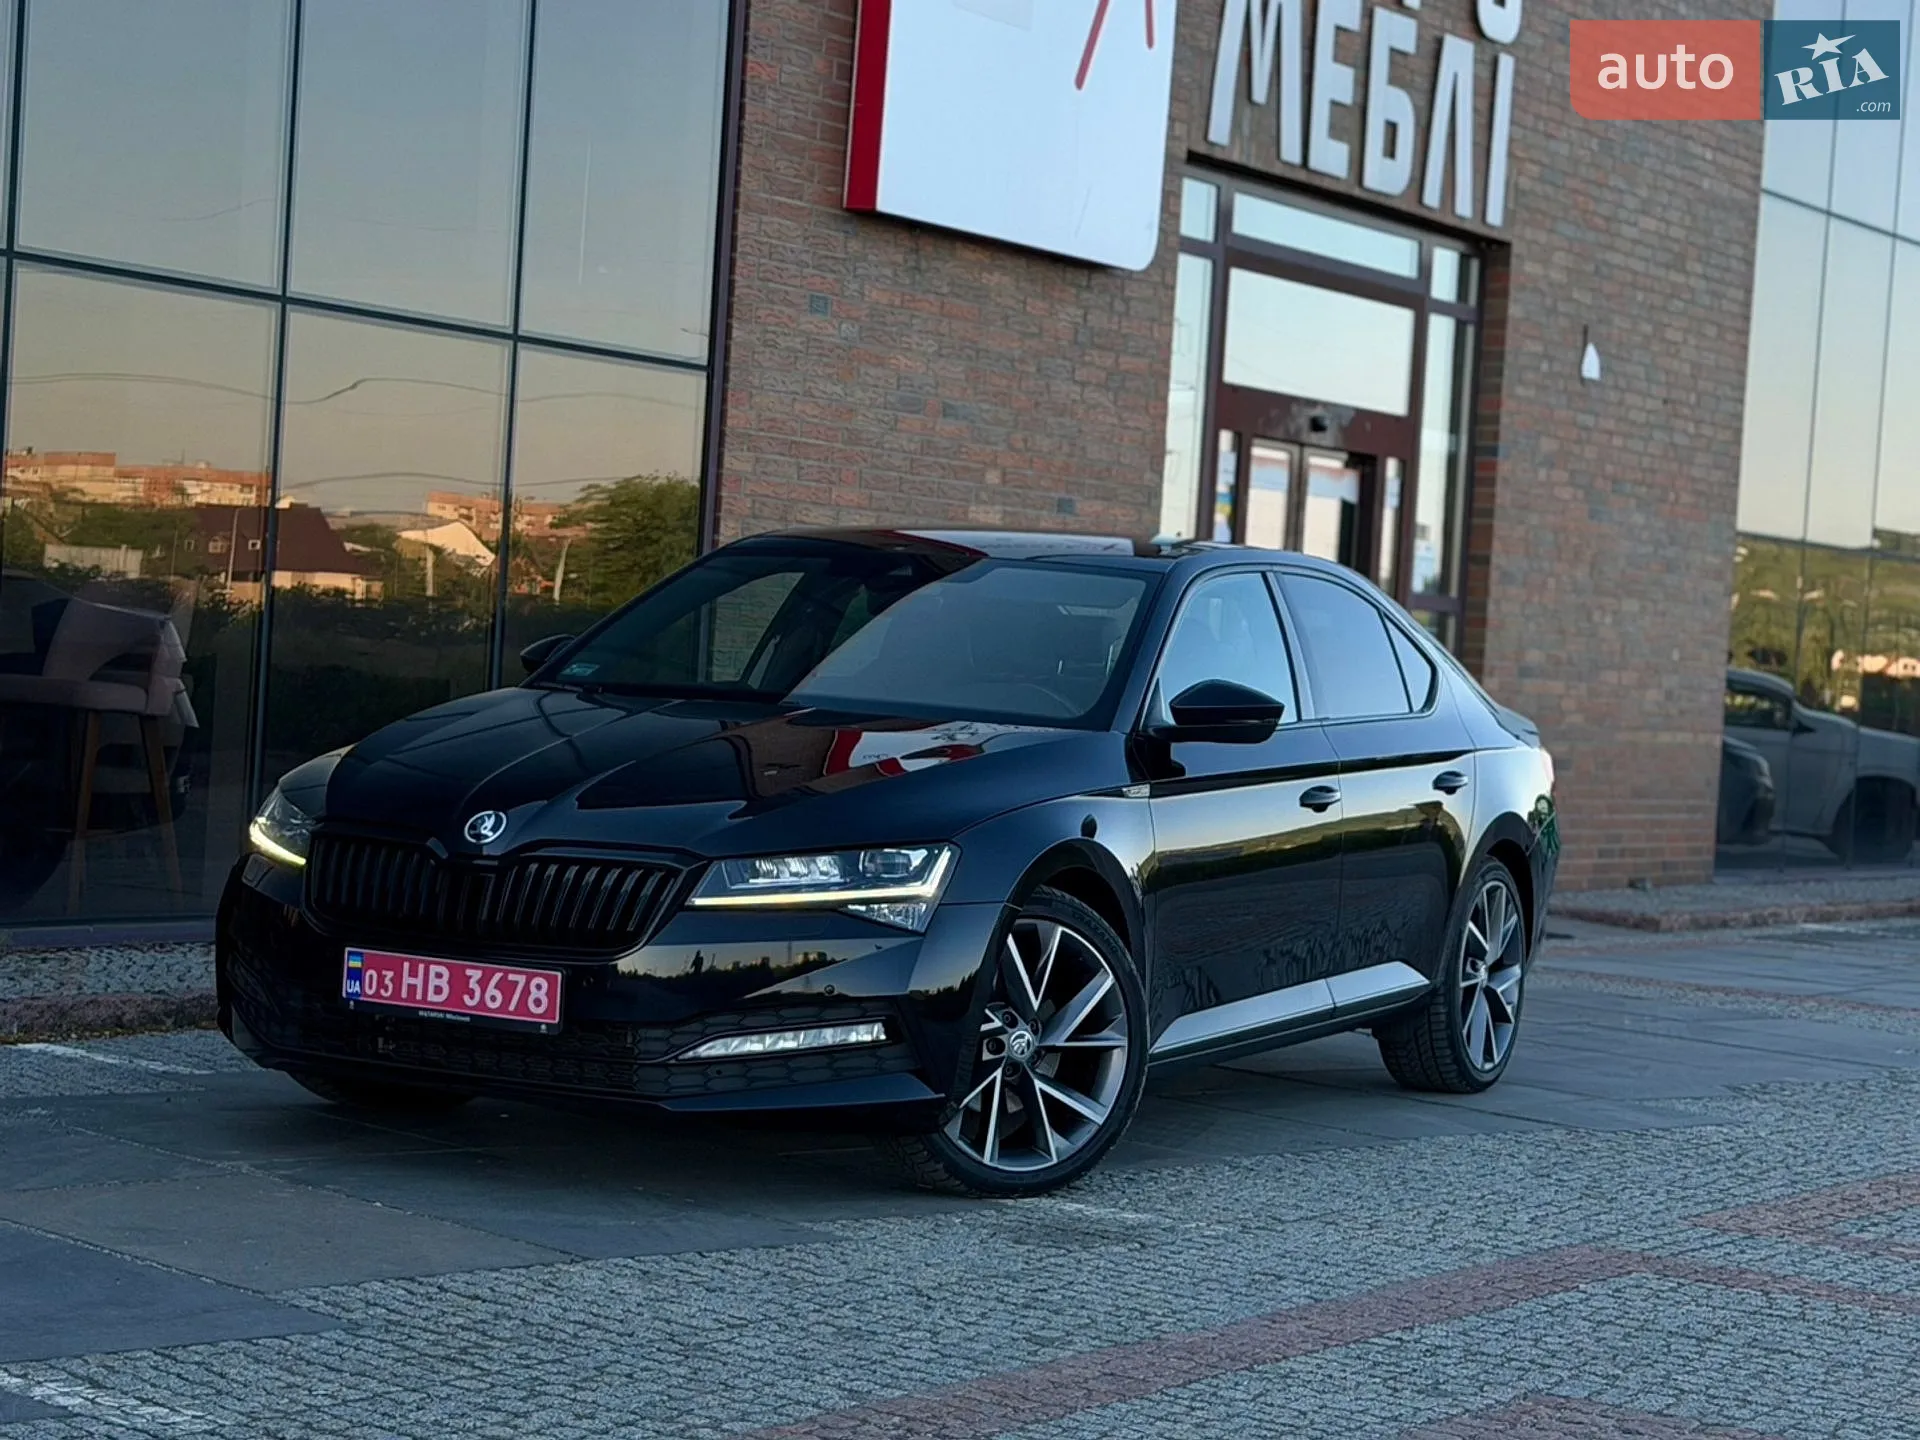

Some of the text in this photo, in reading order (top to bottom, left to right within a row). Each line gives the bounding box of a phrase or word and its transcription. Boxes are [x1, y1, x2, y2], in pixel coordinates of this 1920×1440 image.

[1206, 0, 1515, 228] МЕБЛІ
[346, 979, 361, 995] UA
[364, 961, 549, 1014] 03 HB 3678
